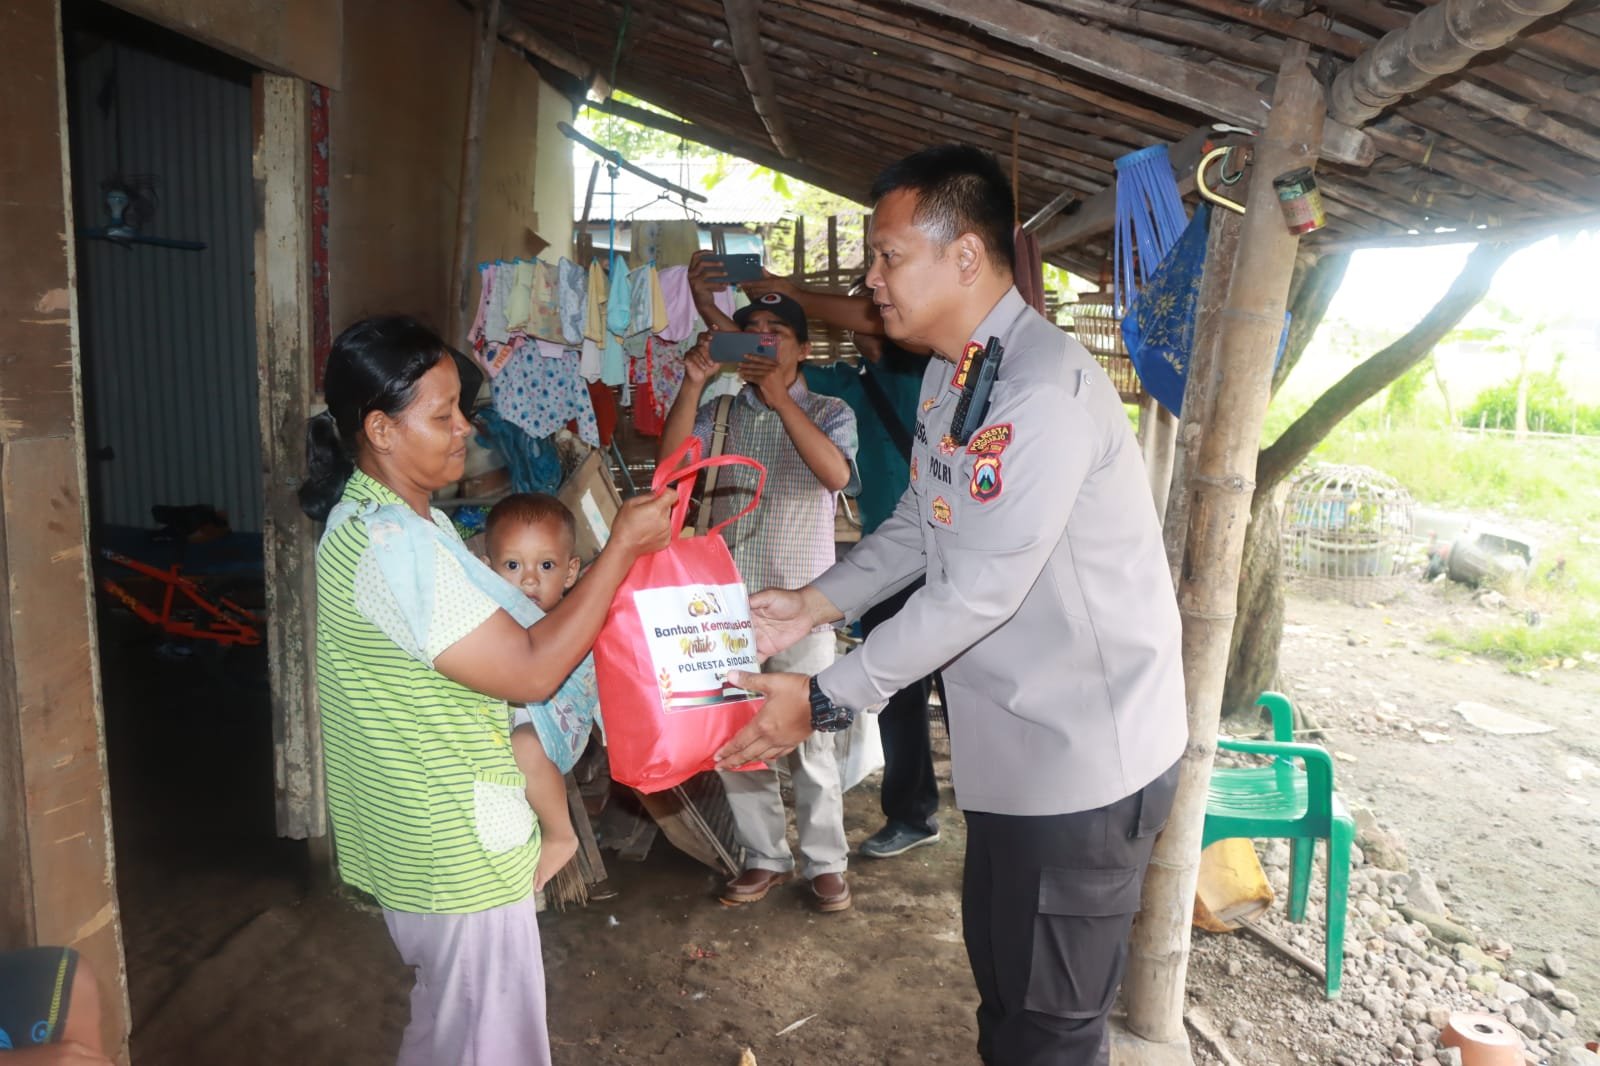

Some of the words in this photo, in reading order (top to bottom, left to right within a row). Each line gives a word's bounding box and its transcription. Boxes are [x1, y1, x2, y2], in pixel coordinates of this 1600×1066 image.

[970, 426, 1009, 451] POLRESTA
[929, 456, 952, 485] POLRI
[655, 624, 700, 638] Bantuan
[680, 635, 717, 658] Untuk
[678, 660, 725, 673] POLRESTA
